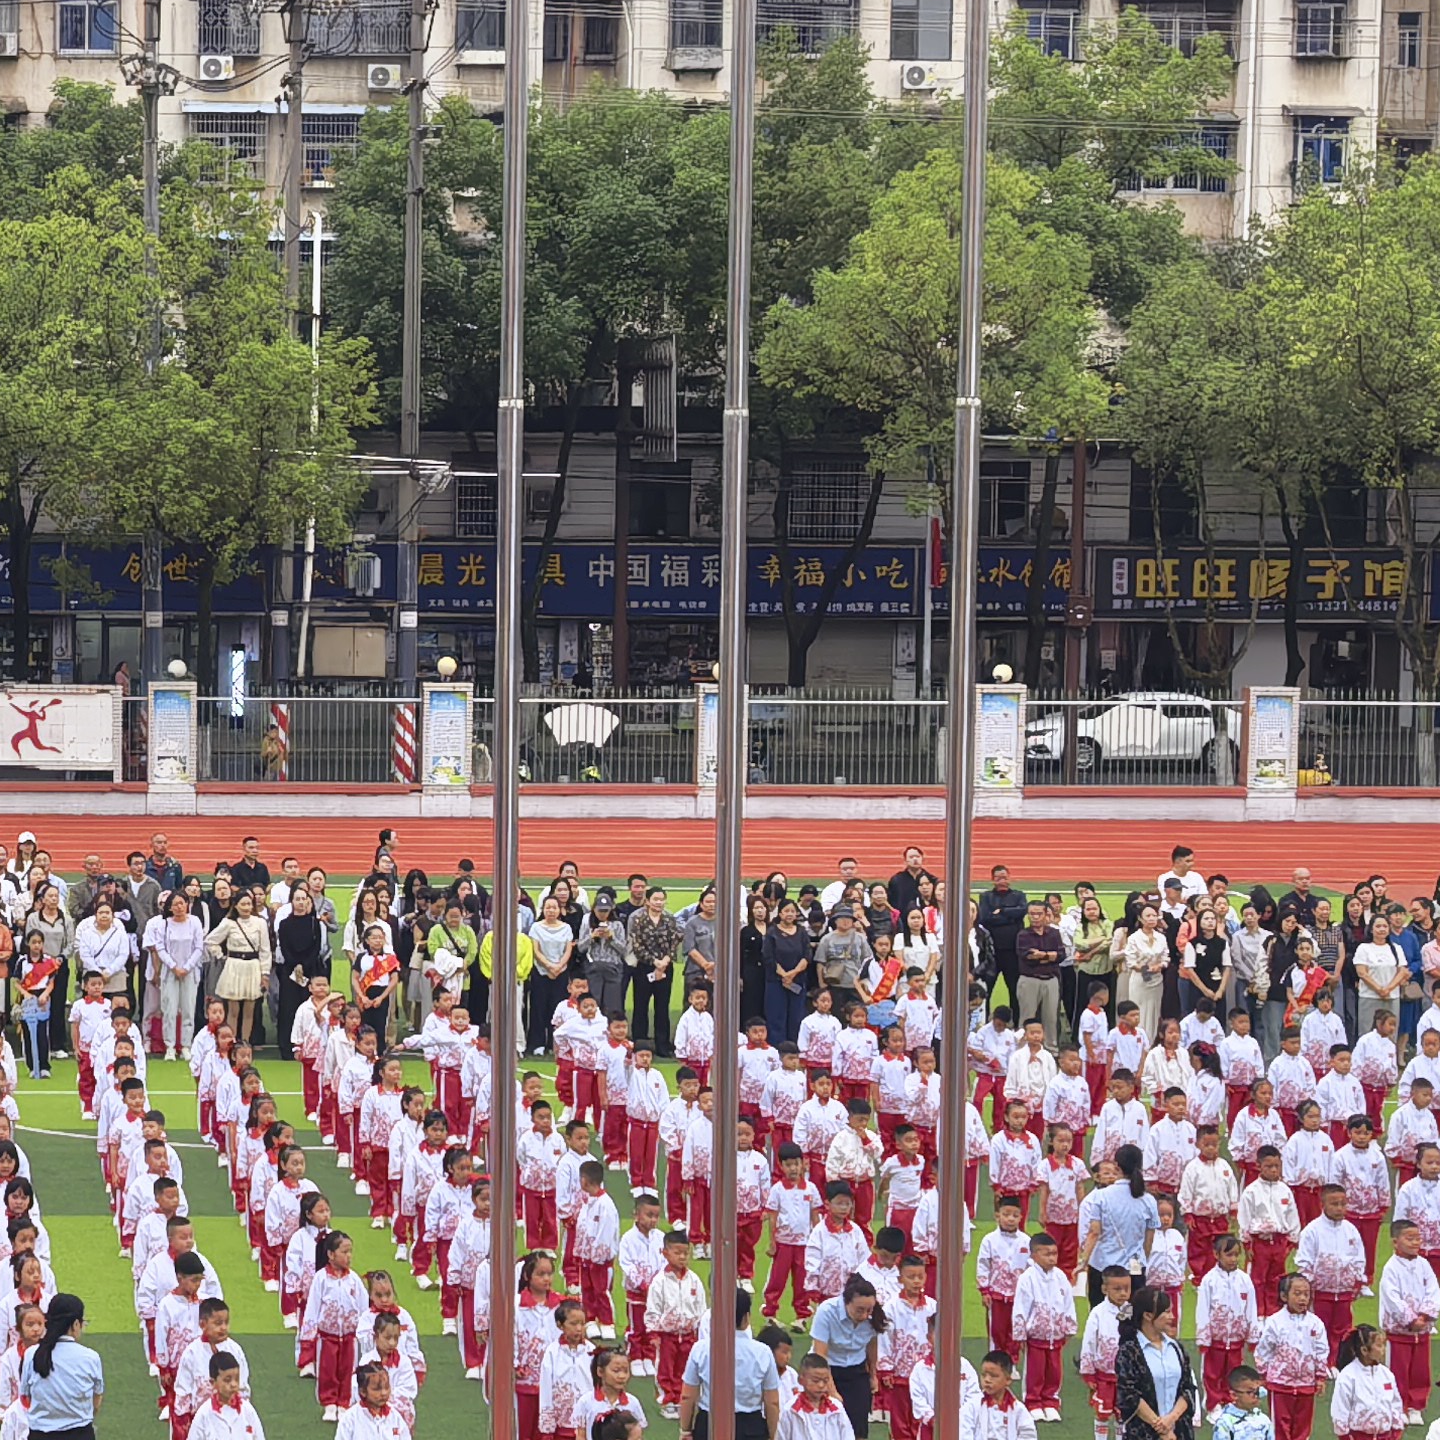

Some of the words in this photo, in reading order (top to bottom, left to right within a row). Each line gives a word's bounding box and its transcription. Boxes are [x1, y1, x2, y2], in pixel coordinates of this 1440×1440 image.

[417, 553, 566, 586] 晨光具
[756, 553, 908, 589] 幸福小吃
